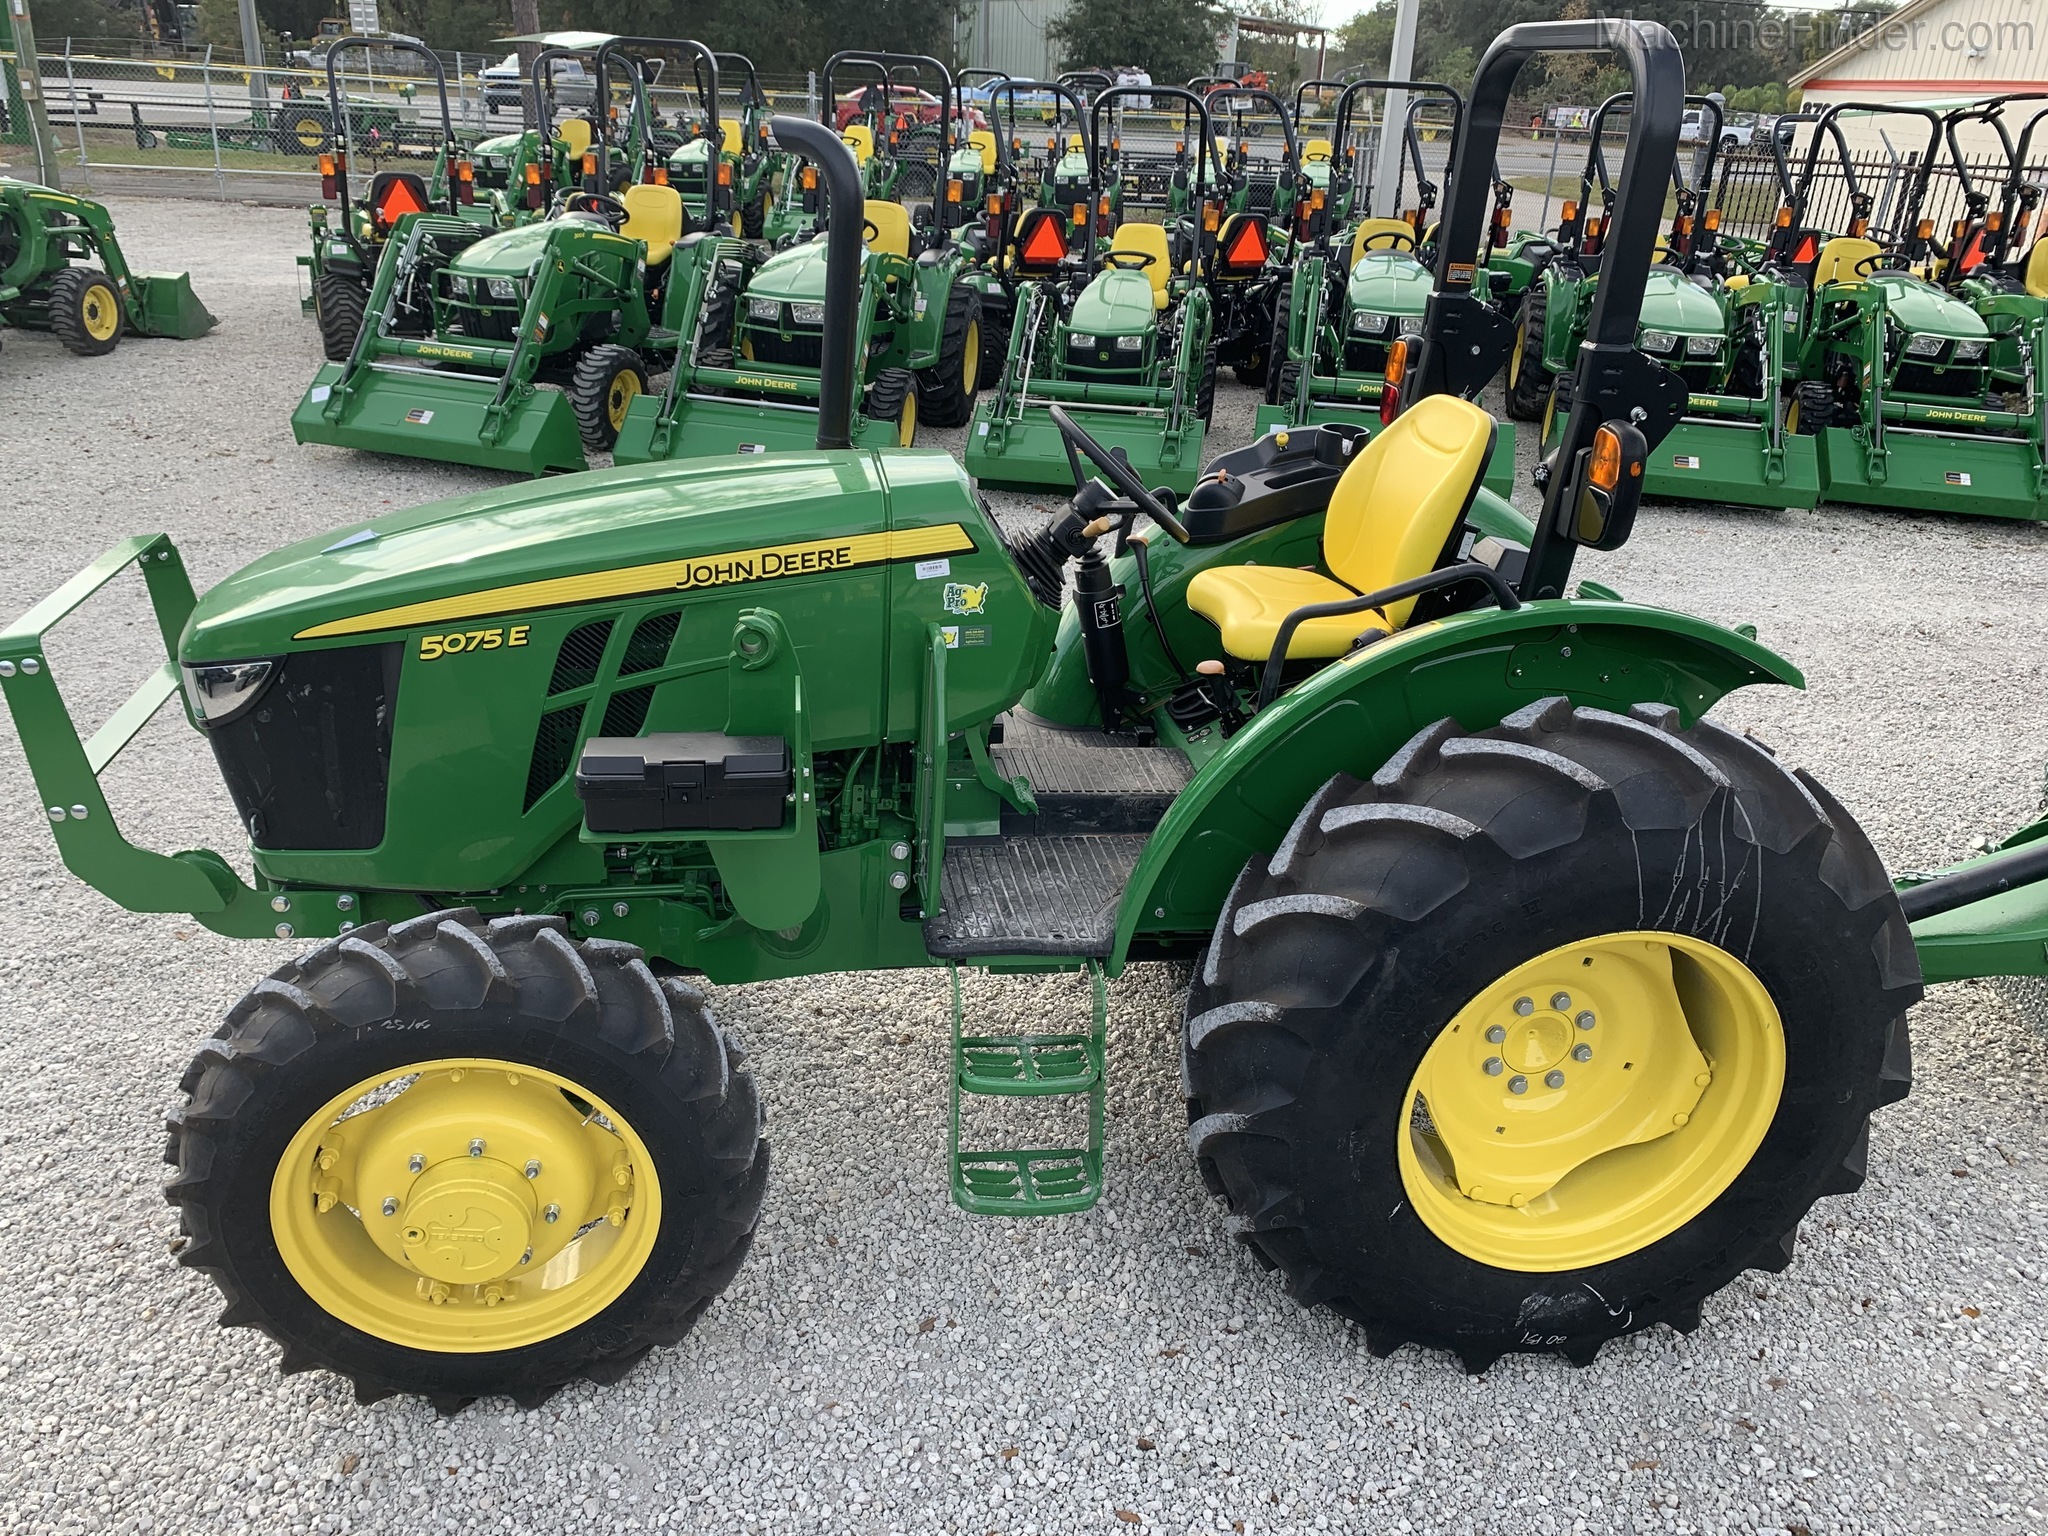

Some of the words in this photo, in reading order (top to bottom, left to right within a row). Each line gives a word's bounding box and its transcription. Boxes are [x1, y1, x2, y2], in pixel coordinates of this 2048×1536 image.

[417, 345, 441, 355] JOHN
[443, 348, 473, 359] DEERE
[735, 376, 762, 386] JOHN
[764, 379, 798, 390] DEERE
[1357, 384, 1383, 393] JOHN
[1926, 410, 1953, 419] JOHN
[1954, 411, 1987, 422] DEERE
[676, 560, 754, 587] JOHN
[761, 546, 852, 575] DEERE
[946, 597, 967, 608] Pro
[420, 628, 503, 660] 5075
[508, 625, 530, 647] E
